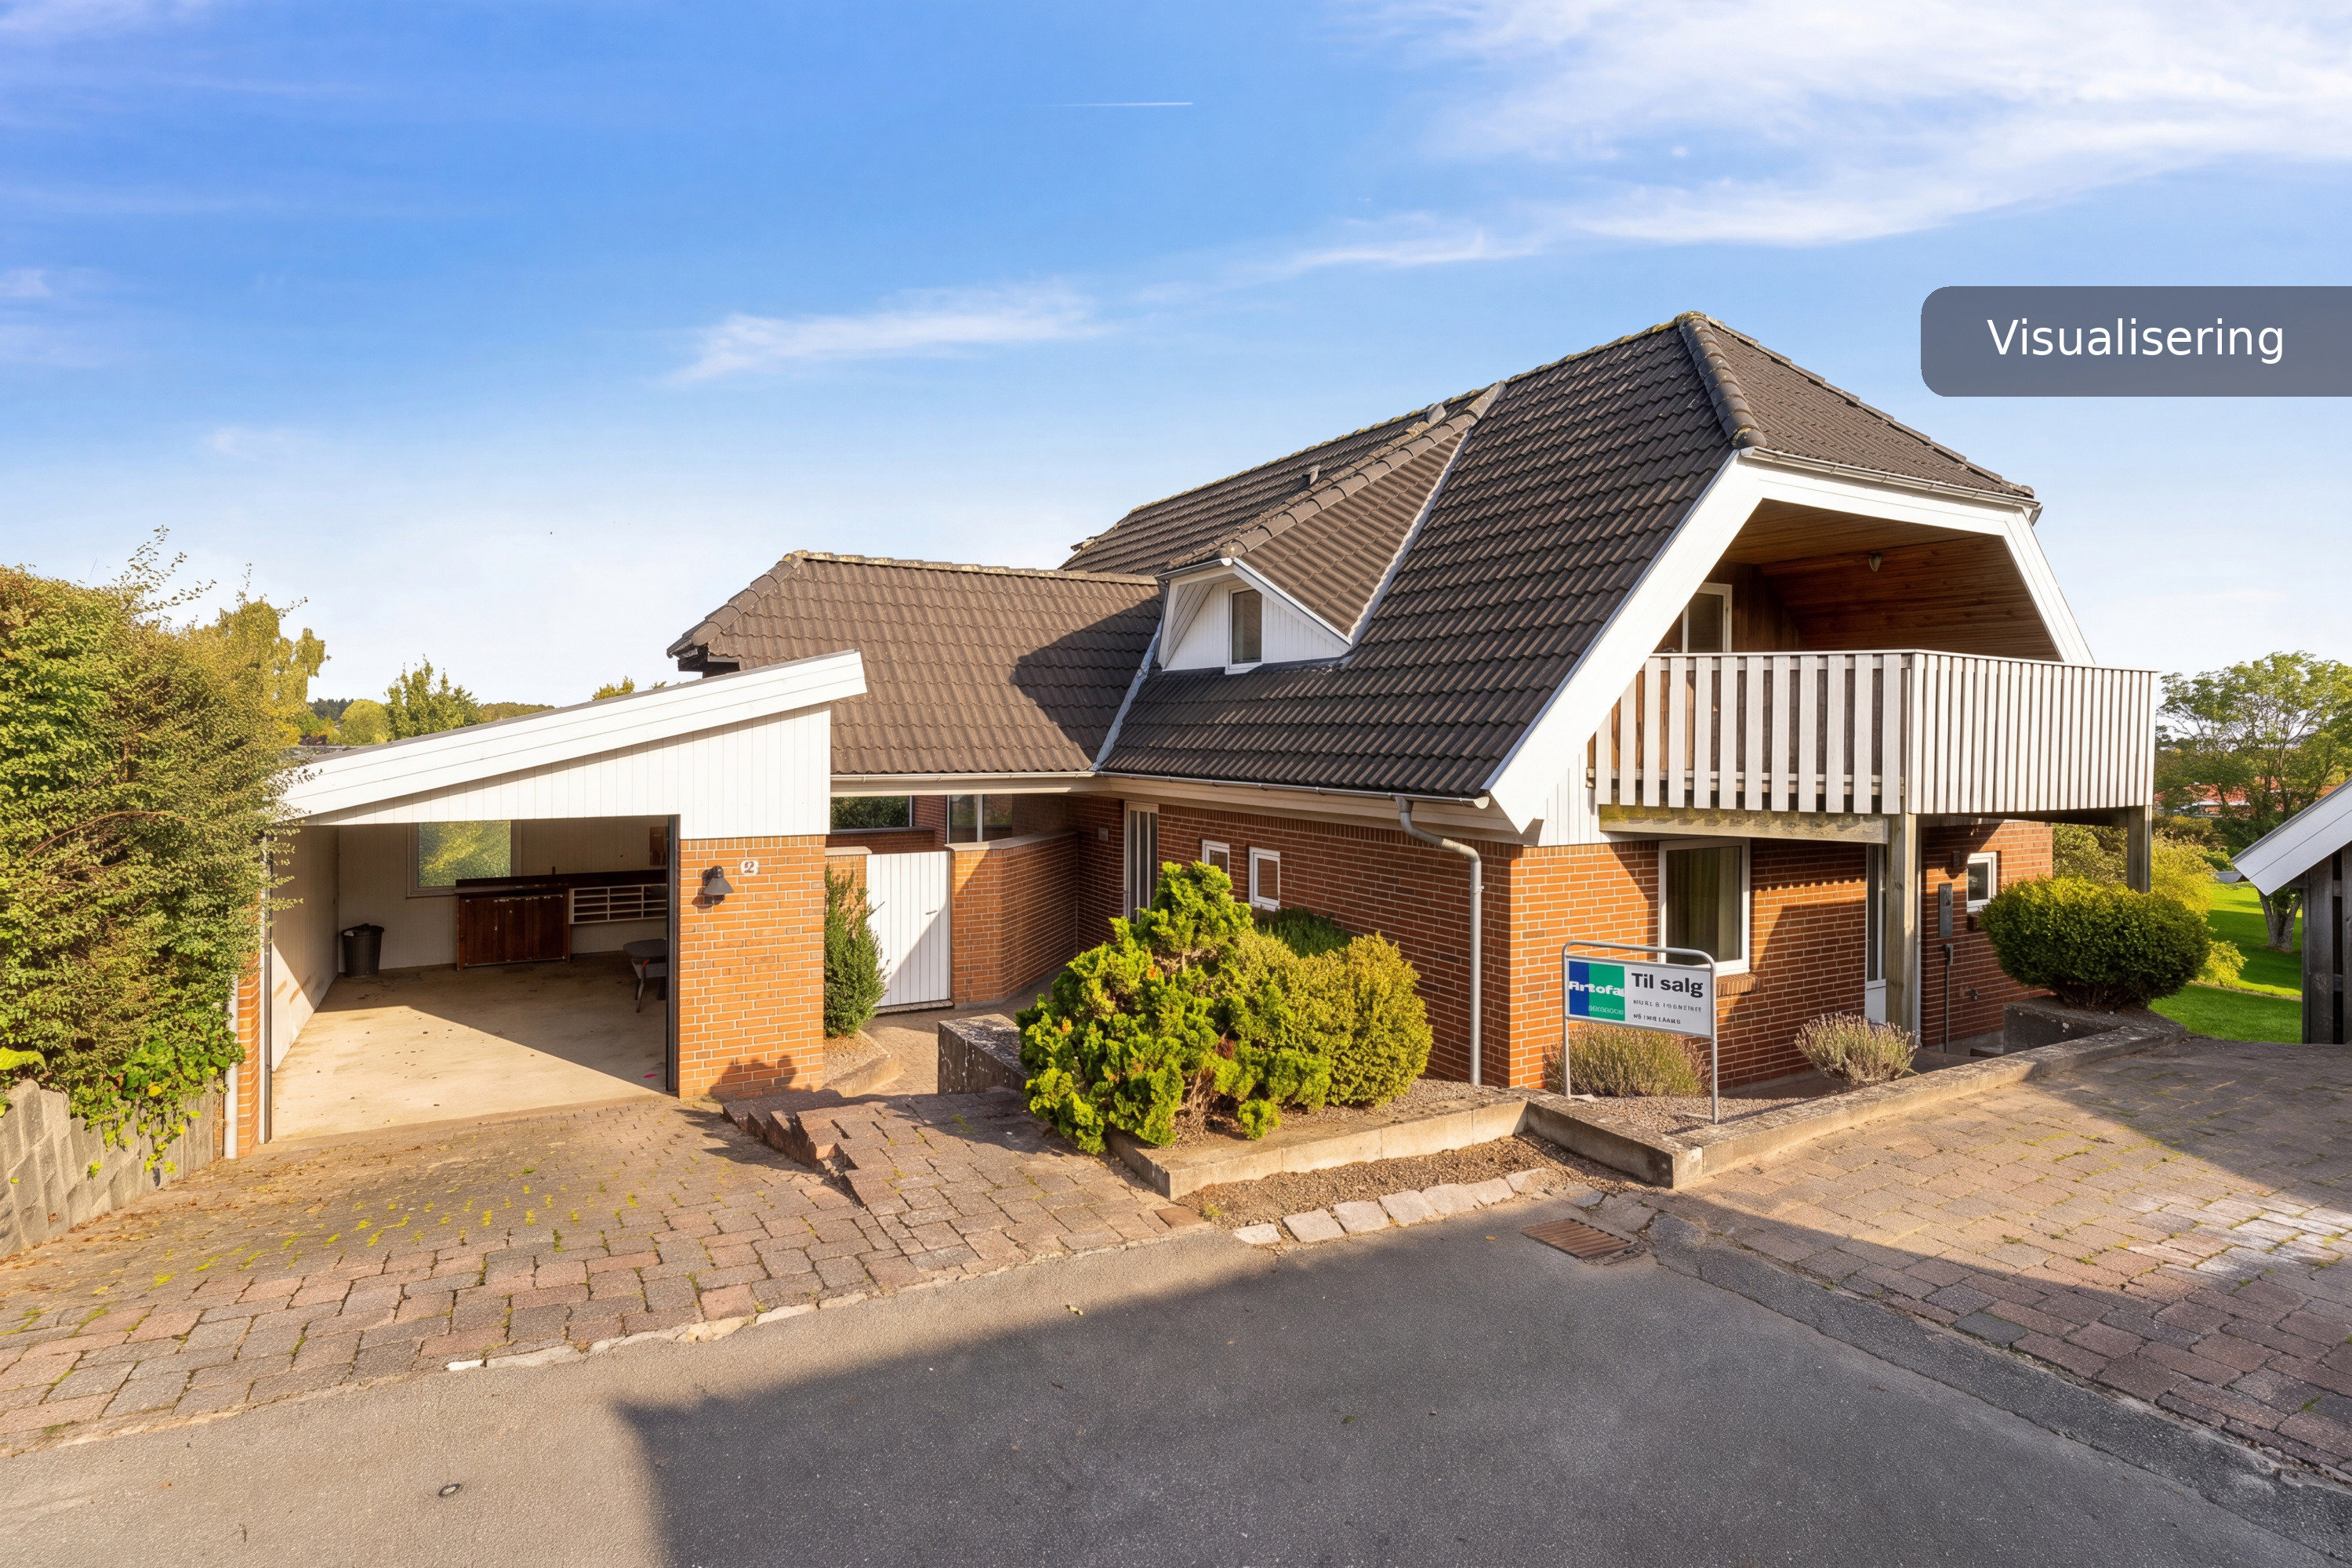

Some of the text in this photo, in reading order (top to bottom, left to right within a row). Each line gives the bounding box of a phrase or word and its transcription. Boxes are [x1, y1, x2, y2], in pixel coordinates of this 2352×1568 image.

[744, 861, 755, 873] 2
[1631, 972, 1704, 999] Til salg
